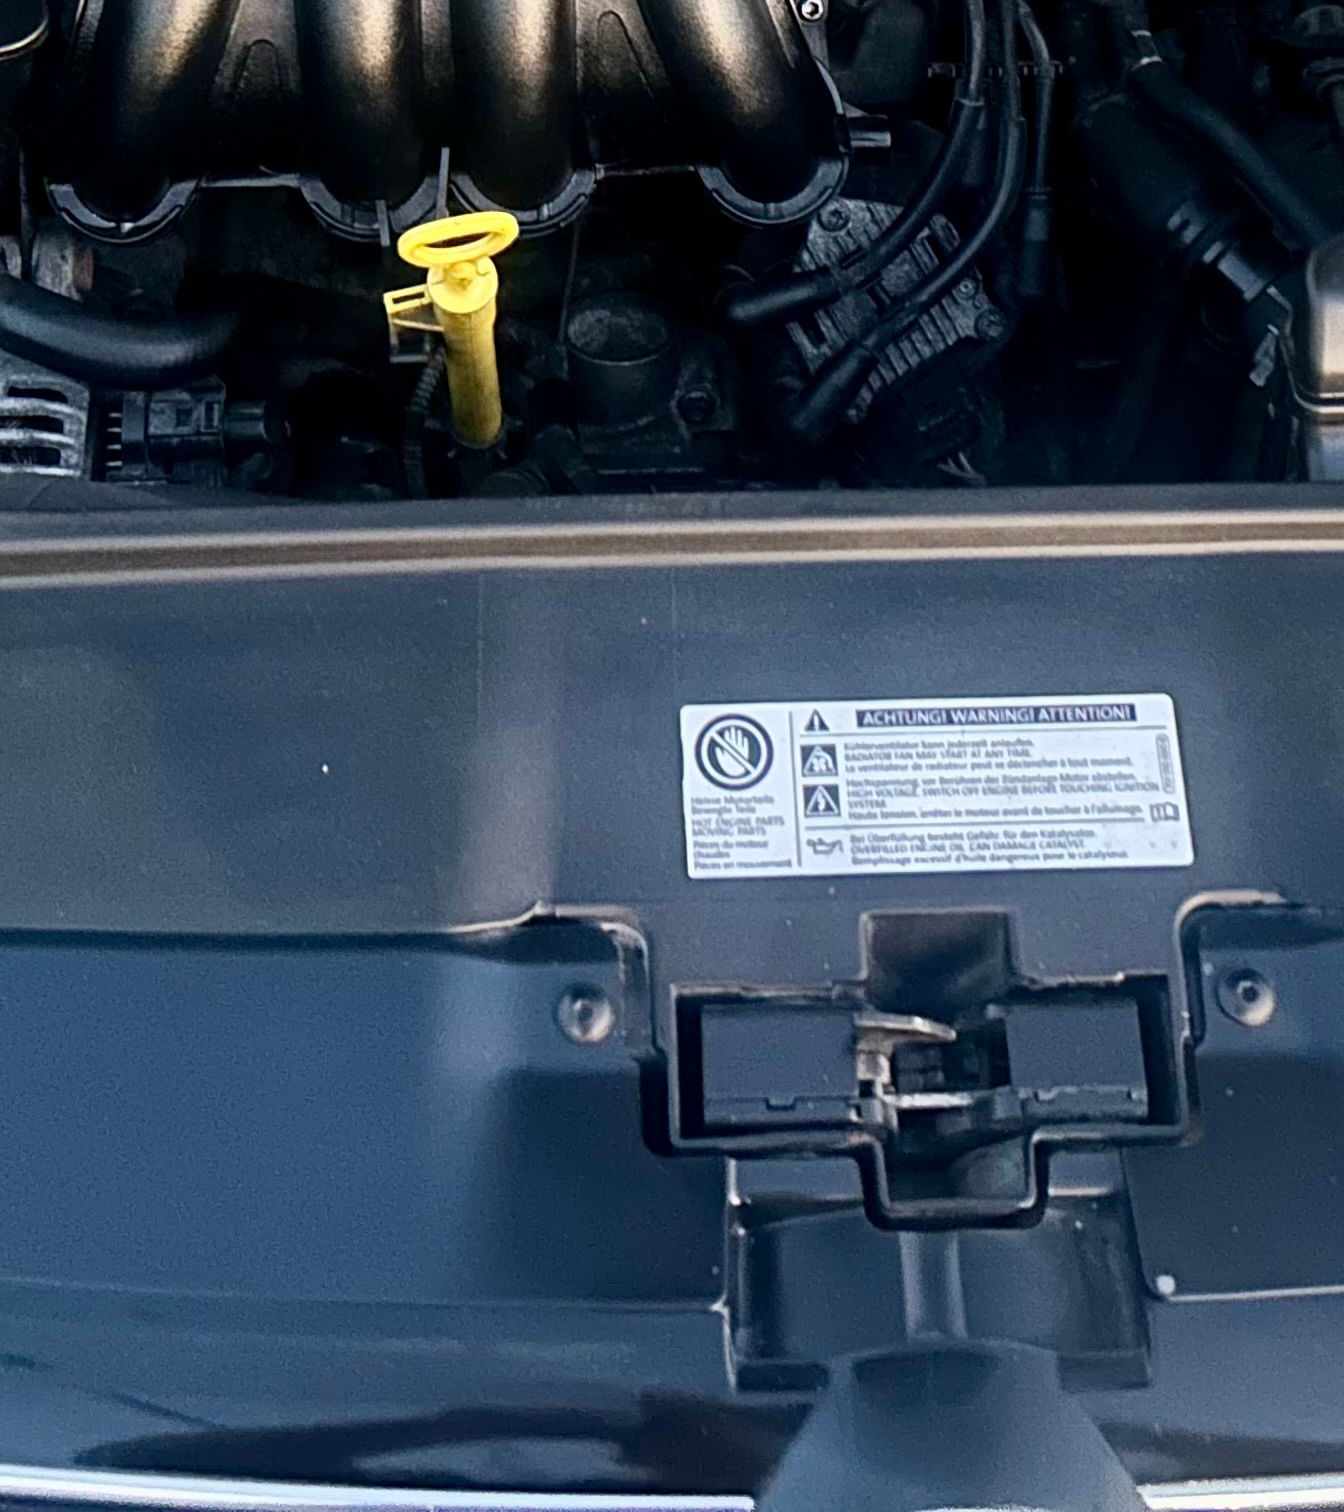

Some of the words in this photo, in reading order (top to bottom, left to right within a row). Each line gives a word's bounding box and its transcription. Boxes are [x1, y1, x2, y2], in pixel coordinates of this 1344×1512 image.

[863, 709, 947, 726] ACHTUNG!
[950, 706, 1035, 724] WARNING!
[1039, 704, 1131, 721] ATTENTION!
[941, 750, 967, 759] START
[971, 750, 981, 758] AT
[985, 749, 1003, 758] ANY
